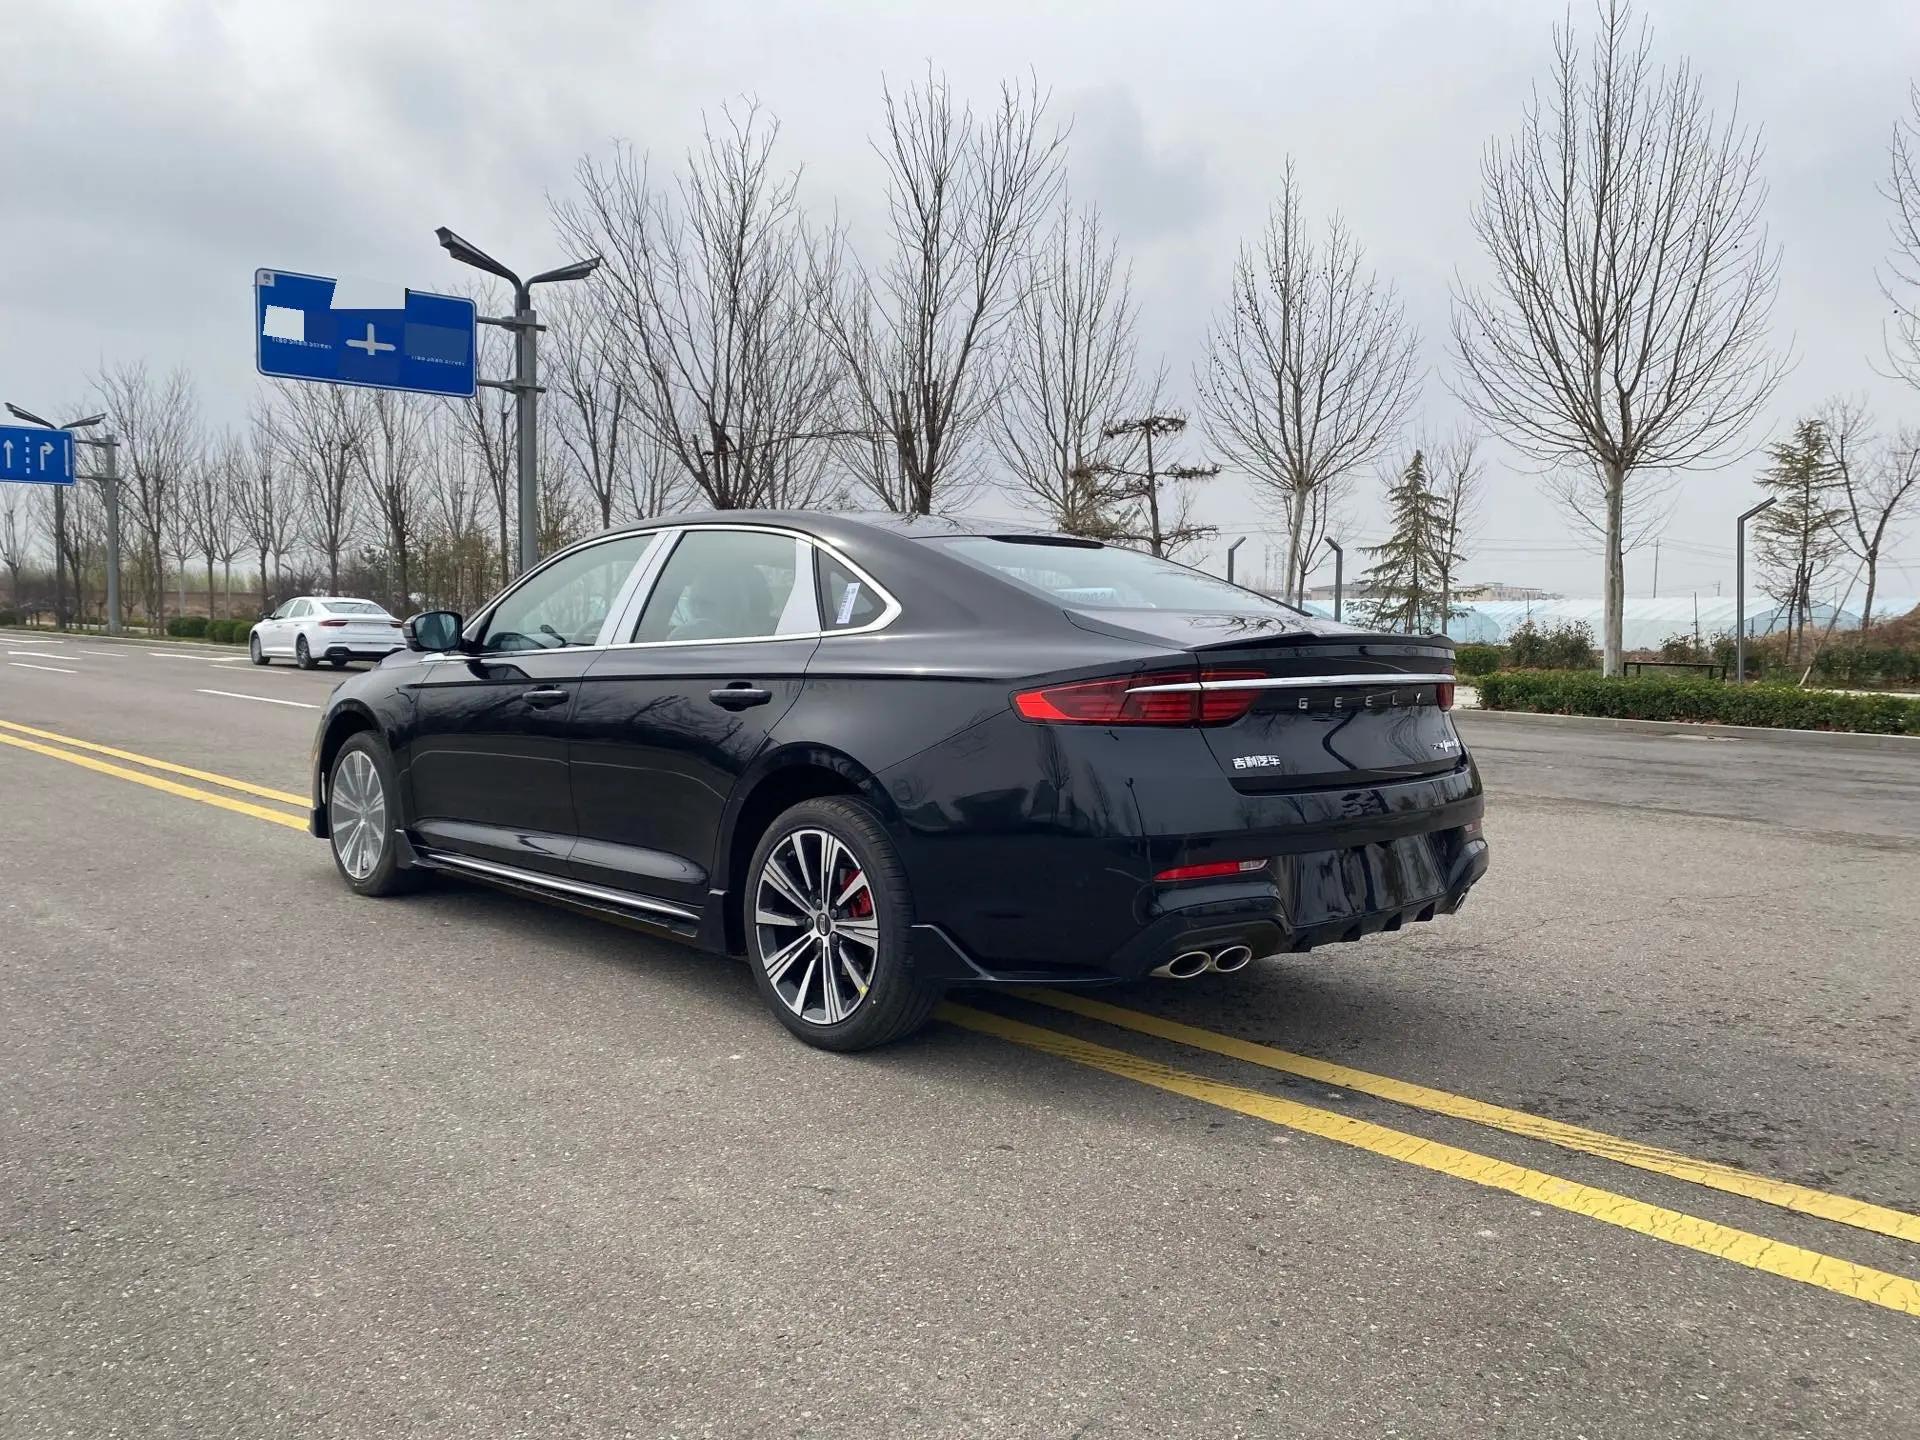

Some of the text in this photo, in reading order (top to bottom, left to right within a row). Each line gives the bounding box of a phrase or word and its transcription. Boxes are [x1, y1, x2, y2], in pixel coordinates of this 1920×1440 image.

[1298, 692, 1421, 710] GEELY
[1232, 754, 1281, 770] 吉利汽车
